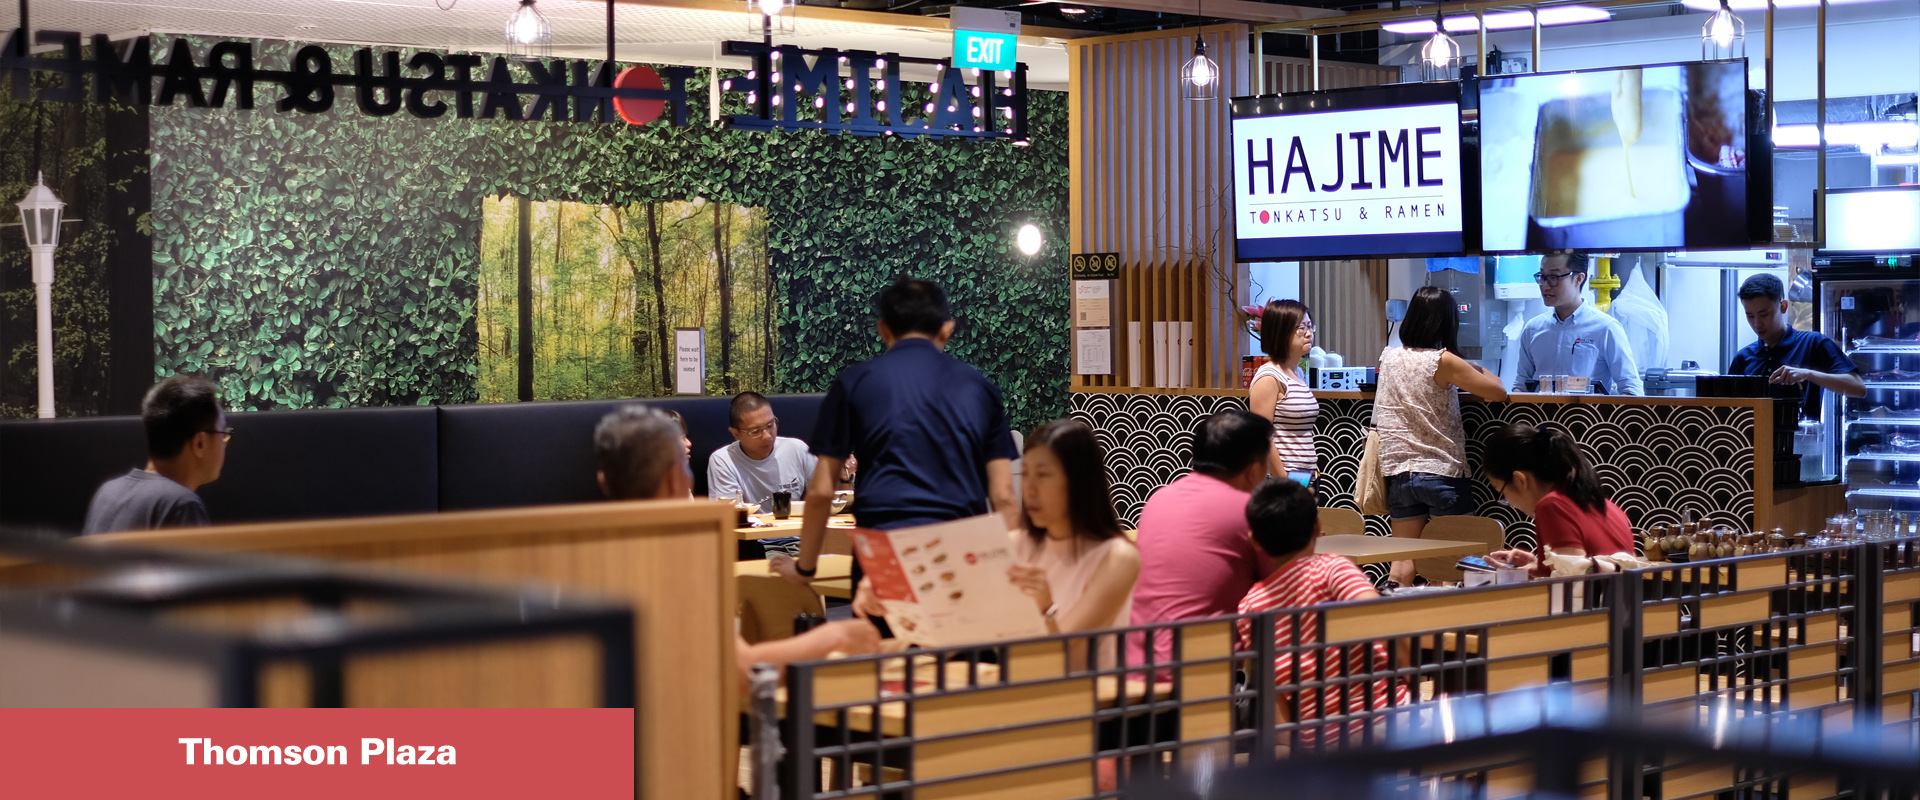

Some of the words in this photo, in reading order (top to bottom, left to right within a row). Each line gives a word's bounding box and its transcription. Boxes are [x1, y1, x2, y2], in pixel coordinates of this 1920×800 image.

[966, 36, 1004, 64] EXIT
[1247, 126, 1443, 195] HAJIME
[1250, 208, 1342, 224] TONKATSU
[1359, 206, 1368, 220] &
[1385, 203, 1445, 219] RAMEN
